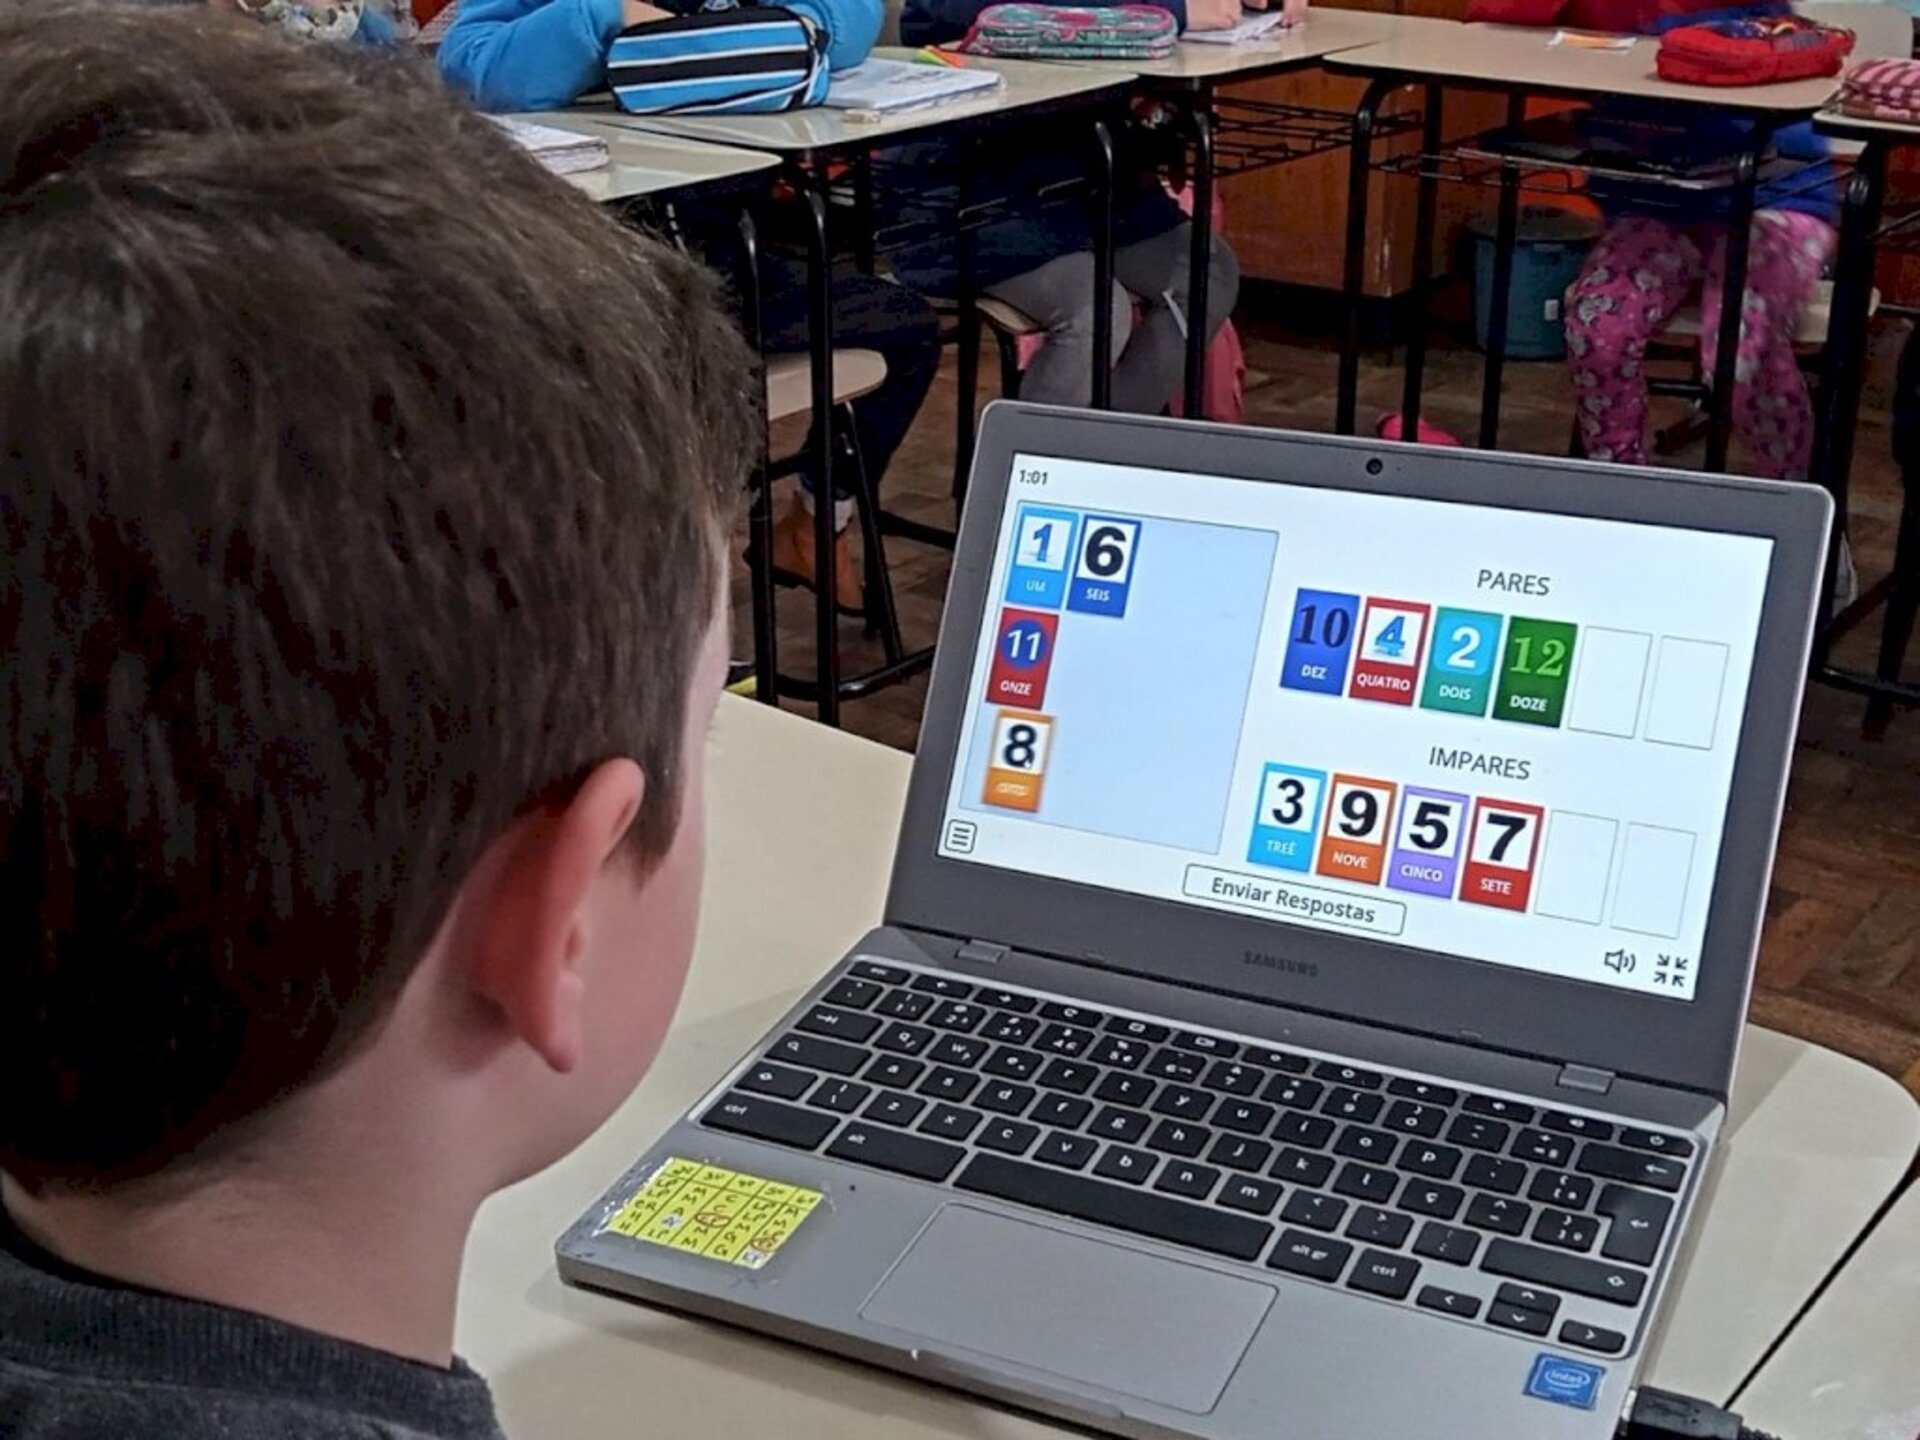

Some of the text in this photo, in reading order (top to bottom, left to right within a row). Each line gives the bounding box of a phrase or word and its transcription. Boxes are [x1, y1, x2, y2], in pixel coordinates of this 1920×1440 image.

[1019, 469, 1048, 485] 1:01
[1033, 523, 1053, 563] 1
[1085, 526, 1127, 577] 6
[1026, 580, 1046, 592] UM
[1086, 588, 1110, 602] SEIS
[1477, 569, 1550, 597] PARES
[1294, 604, 1349, 648] 10
[1374, 615, 1406, 657] 4
[1007, 629, 1041, 661] 11
[1447, 626, 1481, 669] 2
[1510, 636, 1567, 677] 12
[1301, 665, 1328, 680] DEZ
[1357, 672, 1411, 691] QUATRO
[1000, 680, 1033, 696] ONZE
[1439, 684, 1472, 701] DOIS
[1509, 695, 1549, 712] DOZE
[1003, 724, 1037, 768] 8
[1428, 746, 1532, 780] IMPARES
[1272, 778, 1305, 824] 3
[1338, 790, 1378, 837] 9
[1409, 802, 1451, 850] 5
[1486, 813, 1527, 861] 7
[1333, 851, 1369, 869] NOVE
[1401, 864, 1443, 883] CINCO
[1211, 877, 1376, 923] Enviar Respostas
[1479, 877, 1512, 895] SETE
[724, 1104, 748, 1116] ctrl
[1372, 1265, 1397, 1278] ctrl
